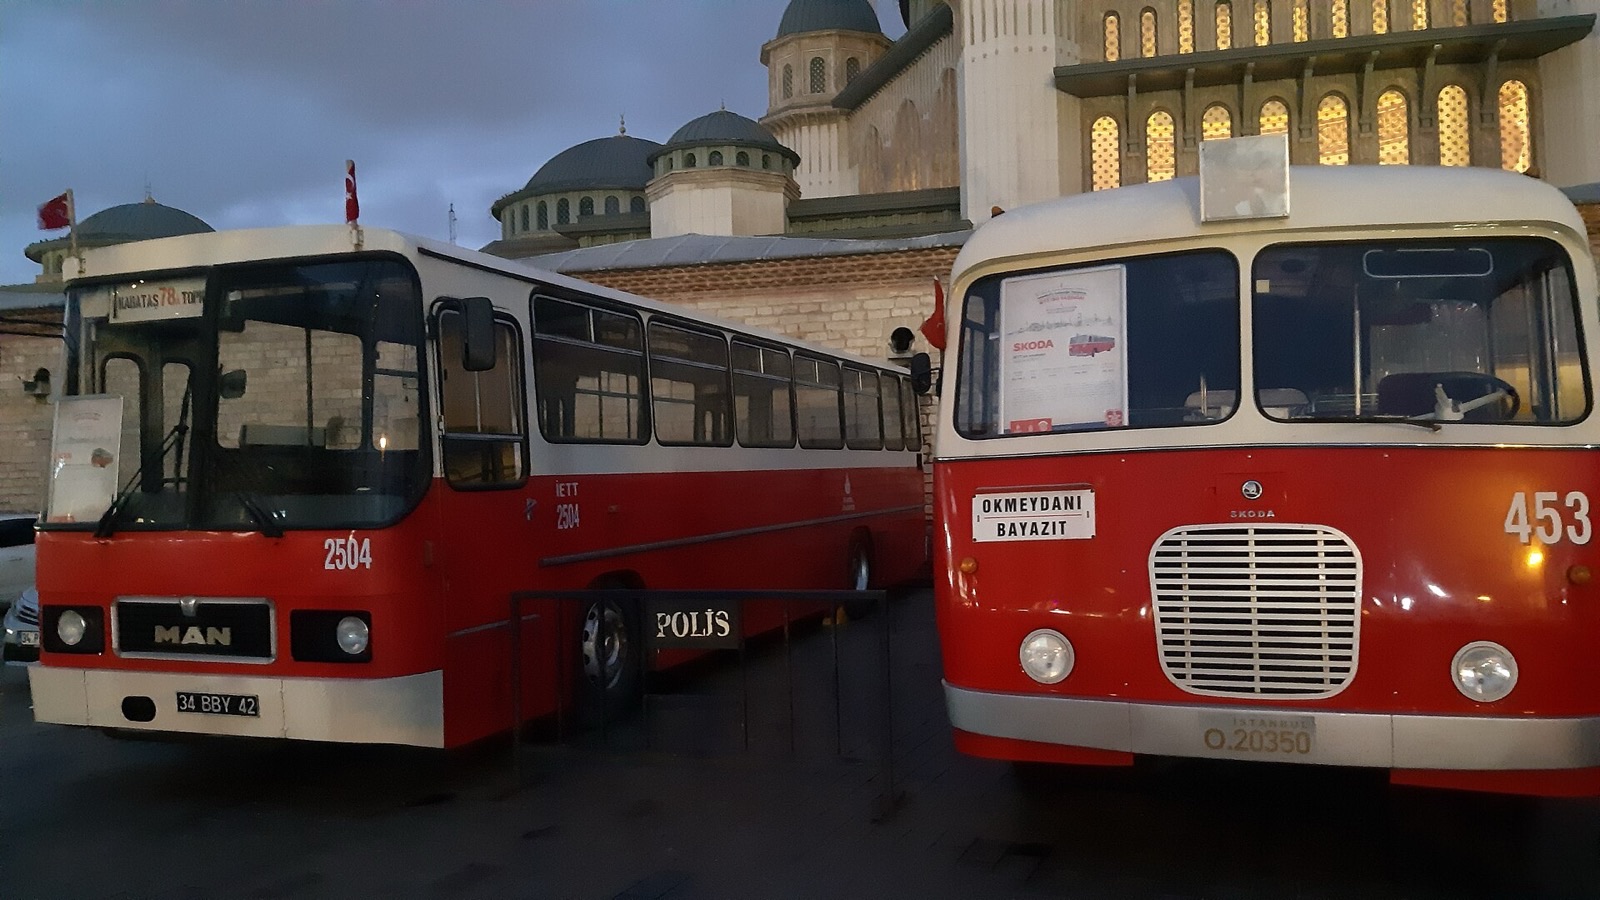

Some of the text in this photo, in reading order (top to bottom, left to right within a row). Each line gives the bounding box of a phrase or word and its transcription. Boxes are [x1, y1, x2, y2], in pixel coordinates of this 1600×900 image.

[1013, 339, 1054, 352] SKODA
[555, 480, 579, 497] İETT
[982, 495, 1082, 513] OKMEYDANI
[1230, 509, 1275, 518] SKODA
[556, 503, 580, 529] 2504
[1504, 491, 1592, 545] 453
[997, 521, 1067, 537] BAYAZIT
[324, 537, 372, 570] 2504
[656, 608, 730, 638] POLİS
[154, 625, 232, 646] MAN
[179, 694, 256, 715] 34 BBY 42
